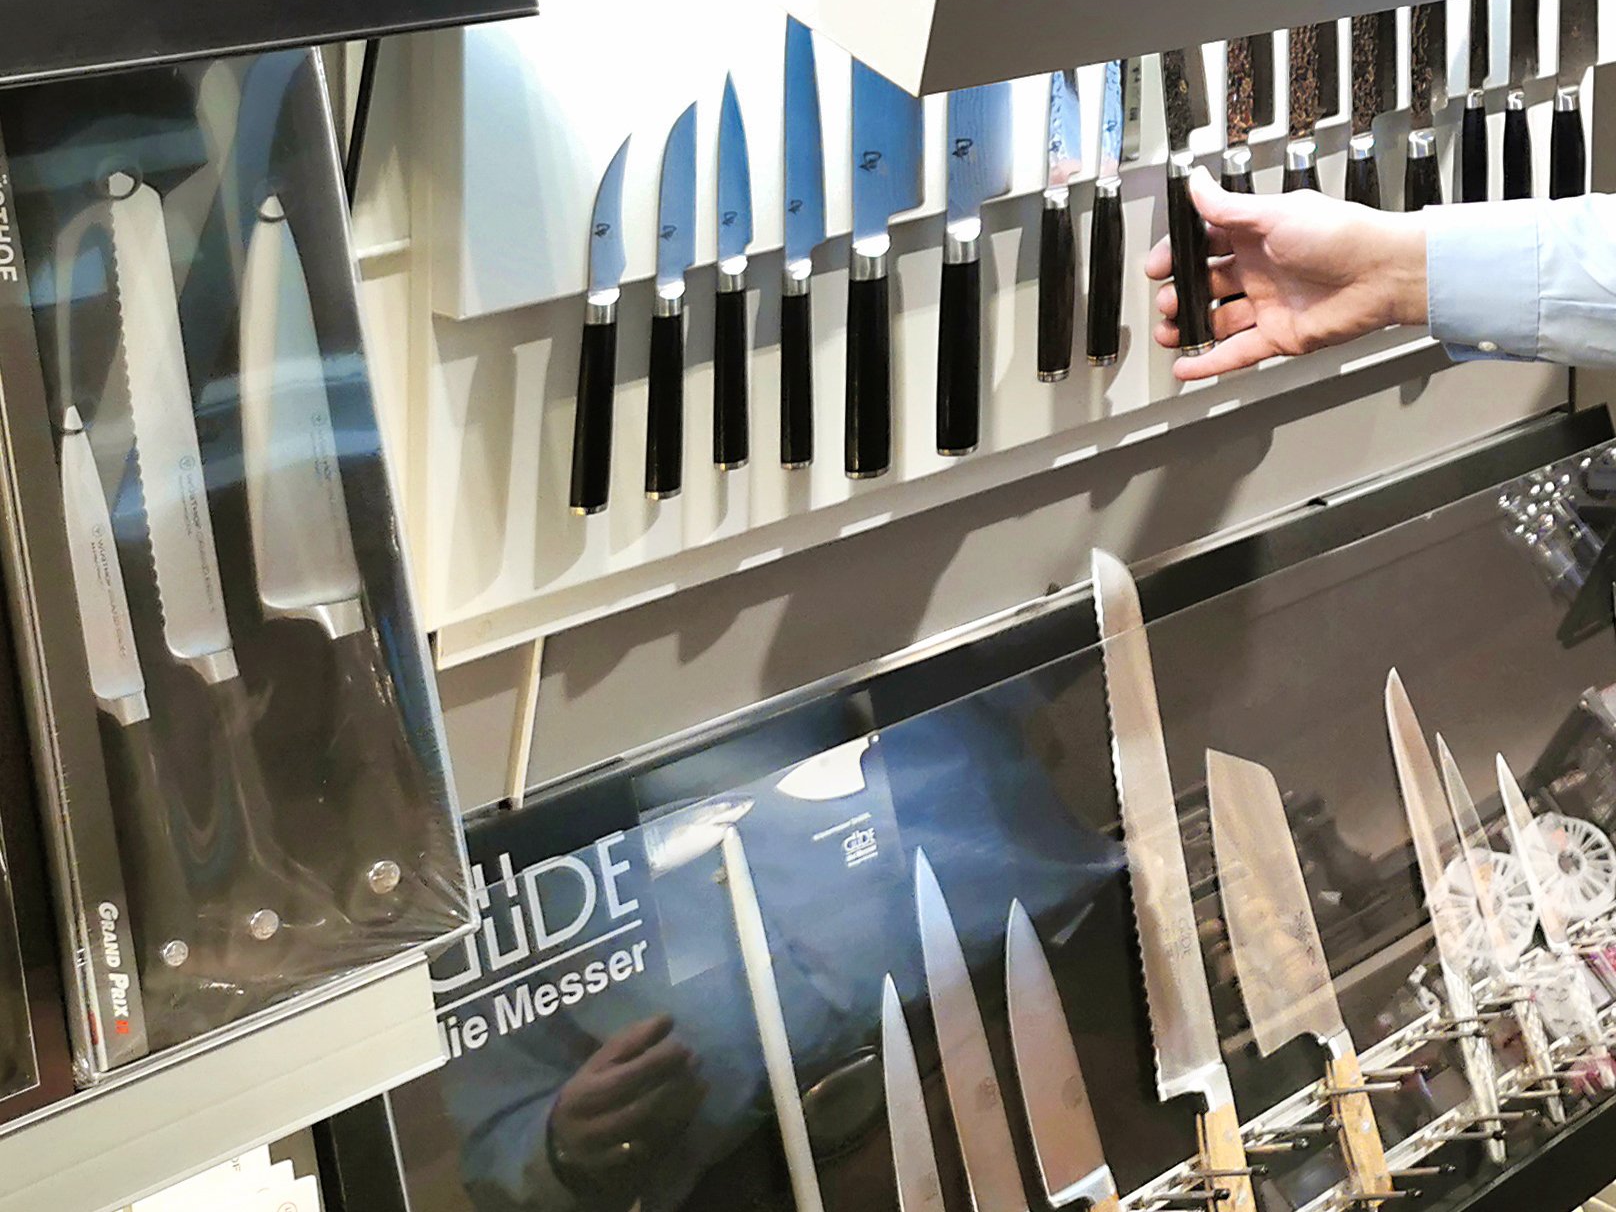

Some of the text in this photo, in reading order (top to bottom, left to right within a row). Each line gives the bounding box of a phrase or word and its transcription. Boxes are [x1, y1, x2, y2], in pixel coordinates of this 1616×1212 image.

[98, 901, 122, 969] GRAND
[108, 972, 130, 1018] PRIX
[493, 940, 648, 1036] Messer
